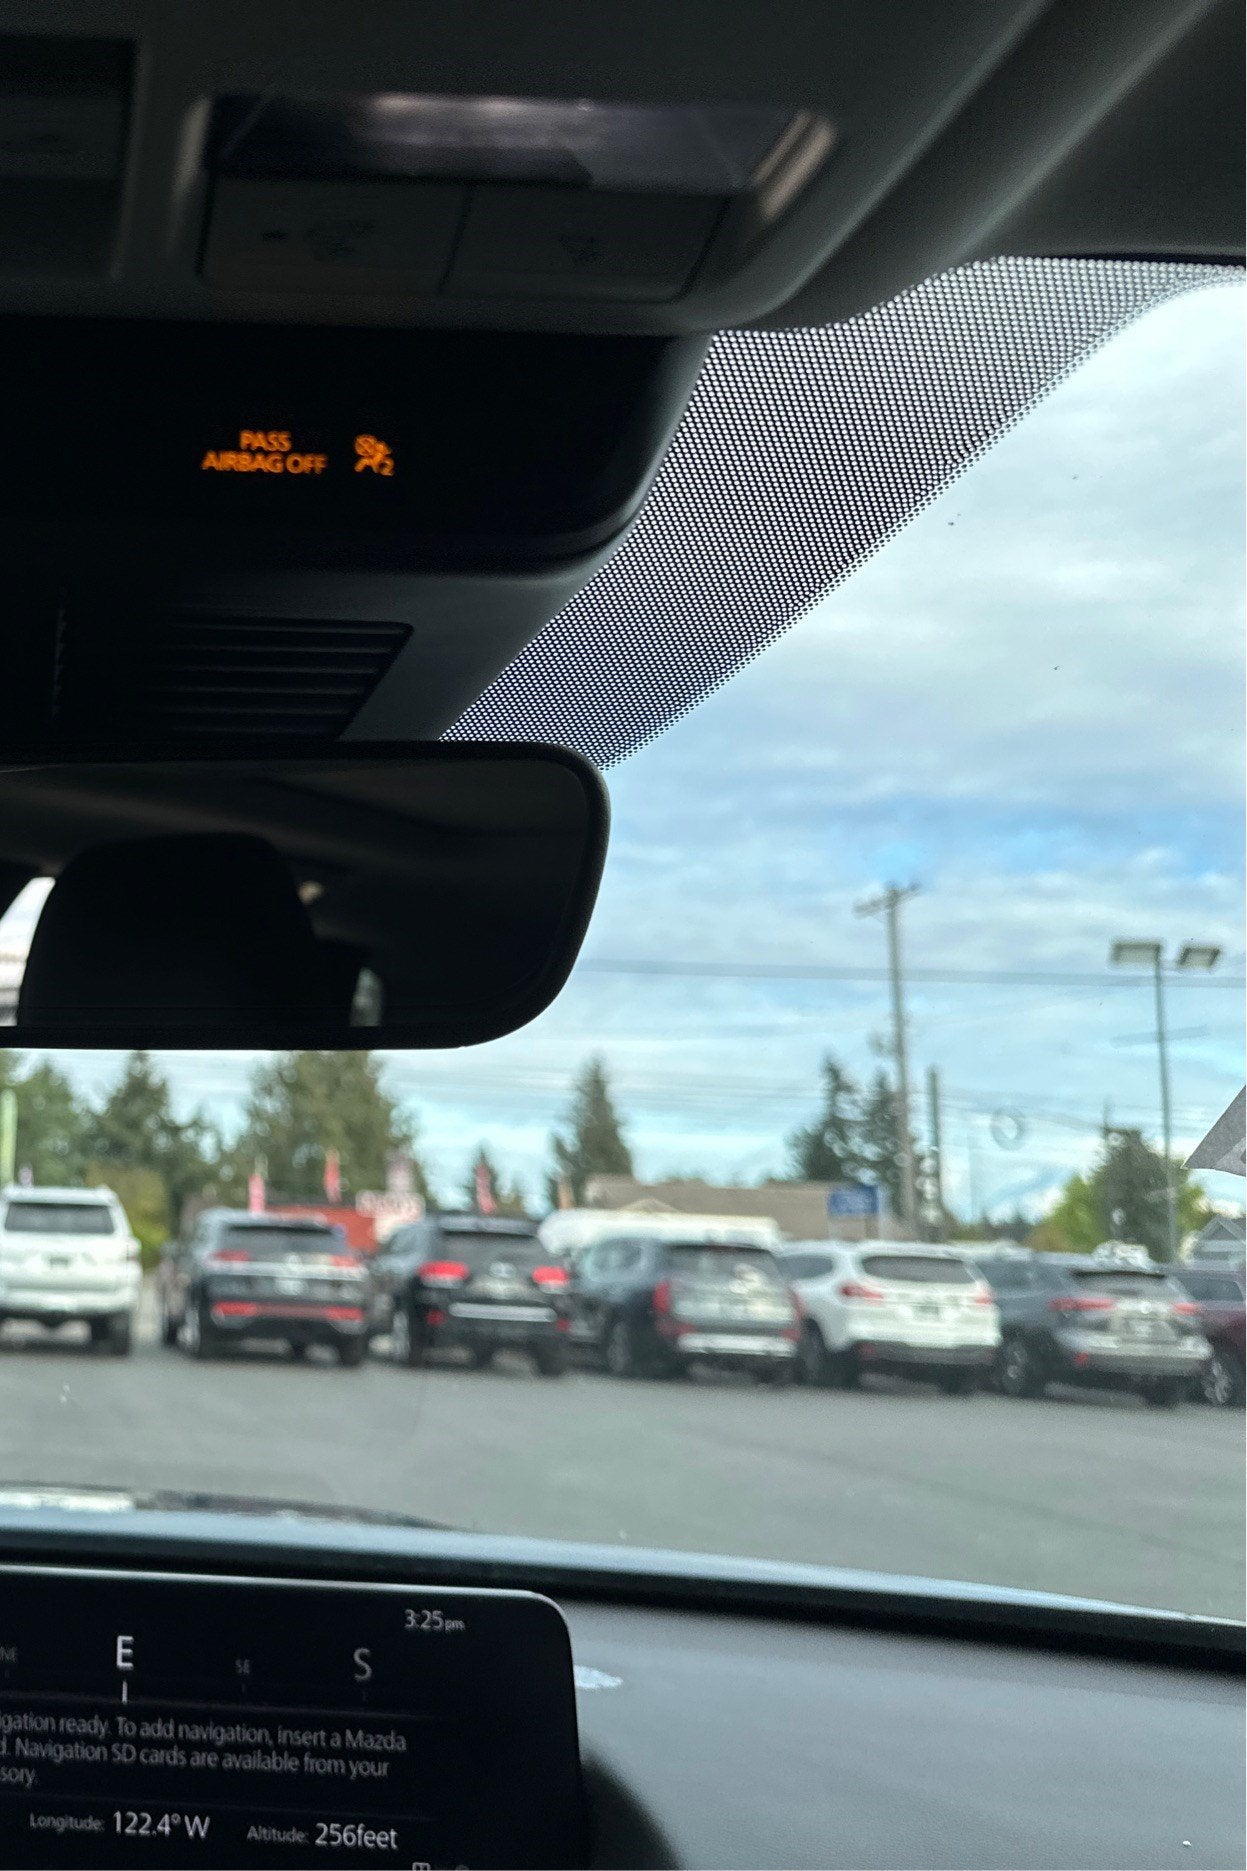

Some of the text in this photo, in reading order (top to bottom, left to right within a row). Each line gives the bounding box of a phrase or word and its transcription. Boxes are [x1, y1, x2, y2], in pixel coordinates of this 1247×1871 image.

[240, 430, 292, 451] PASS
[202, 451, 327, 474] AIRBAG OFF
[116, 1635, 134, 1670] E
[353, 1648, 373, 1682] S
[116, 1716, 136, 1736] To
[140, 1719, 174, 1739] add
[178, 1720, 273, 1746] navigation,
[278, 1727, 326, 1748] insert
[330, 1733, 341, 1748] a
[345, 1730, 407, 1752] Mazda
[15, 1738, 108, 1763] Navigation
[111, 1744, 137, 1763] SD
[140, 1745, 187, 1767] cards
[190, 1750, 218, 1767] are
[222, 1750, 300, 1772] available
[303, 1753, 345, 1775] from
[350, 1759, 390, 1780] your
